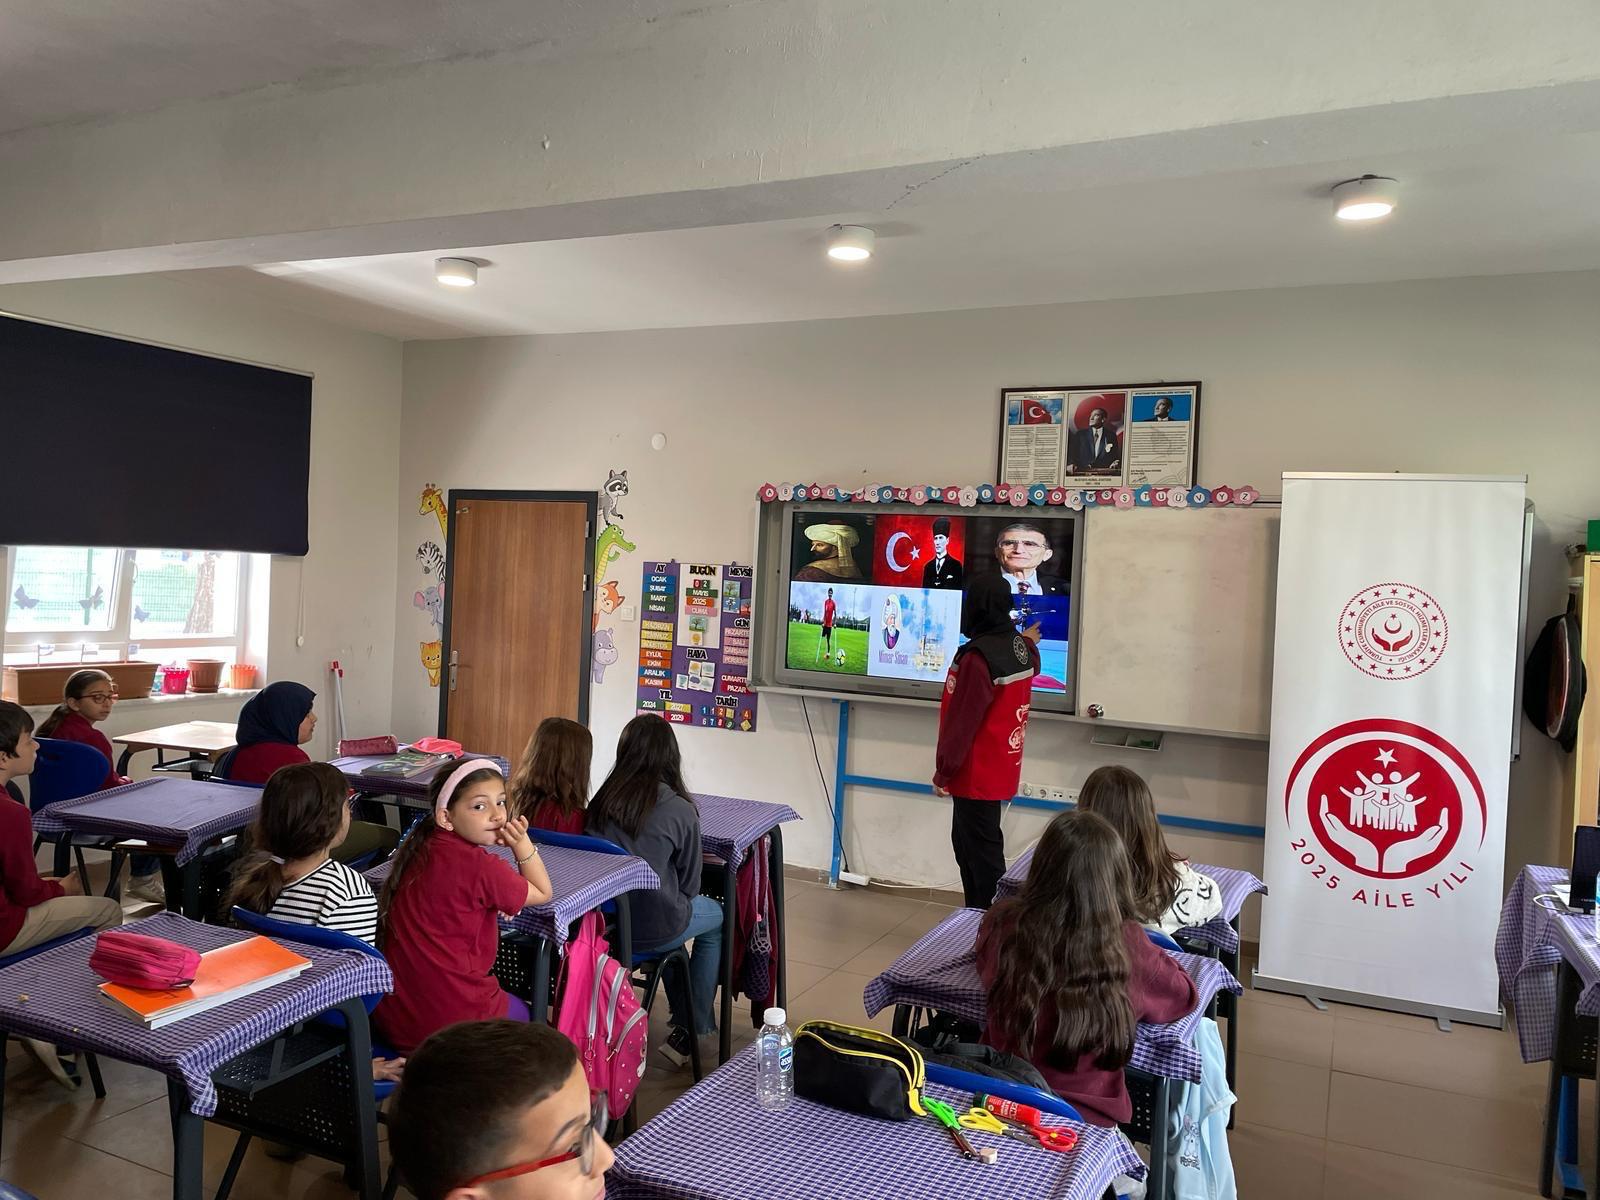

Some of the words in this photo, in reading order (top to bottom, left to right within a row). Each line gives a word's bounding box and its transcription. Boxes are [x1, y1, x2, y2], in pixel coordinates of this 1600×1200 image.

[656, 564, 666, 573] AY
[689, 565, 716, 576] BUGÜN
[651, 575, 667, 583] OCAK
[650, 594, 667, 602] MART
[692, 597, 707, 605] 2025
[649, 604, 666, 612] NİSAN
[1394, 600, 1416, 613] SOSYAL
[687, 649, 707, 660] HAVA
[643, 669, 666, 677] ARALIK
[645, 678, 663, 686] KASIM
[727, 685, 747, 693] PAZAR
[659, 690, 672, 700] YIL
[716, 696, 738, 707] TARİH
[1290, 838, 1341, 890] 2025
[1351, 889, 1415, 909] AİLE
[1426, 861, 1475, 899] YILI
